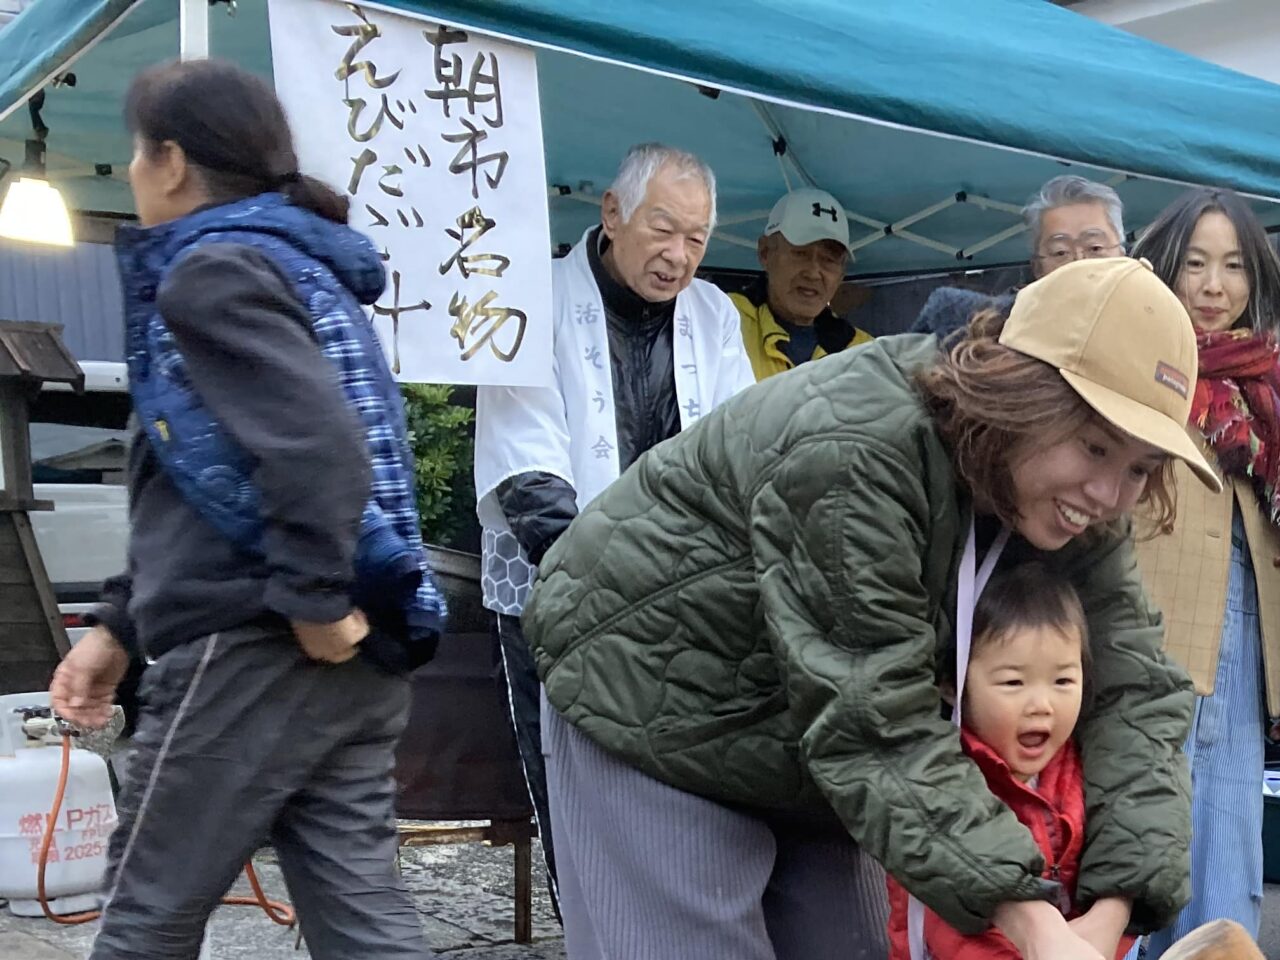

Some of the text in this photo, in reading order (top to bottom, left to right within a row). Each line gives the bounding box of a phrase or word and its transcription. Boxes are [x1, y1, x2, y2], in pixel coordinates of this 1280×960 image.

[422, 25, 528, 362] 朝市名物
[575, 302, 615, 460] 活そう会
